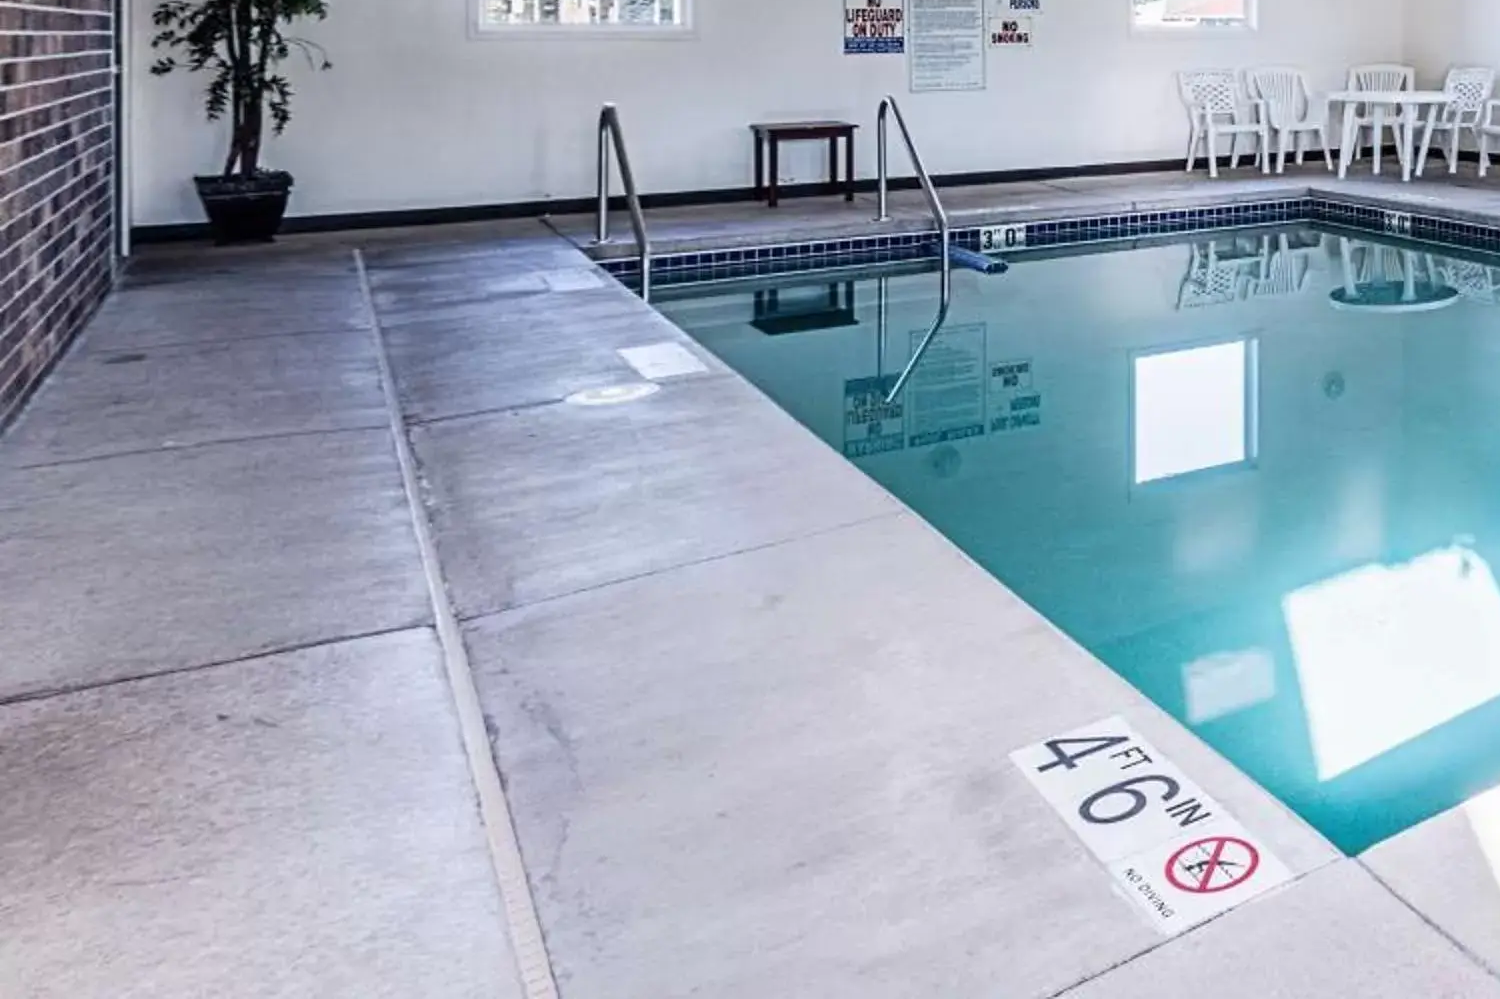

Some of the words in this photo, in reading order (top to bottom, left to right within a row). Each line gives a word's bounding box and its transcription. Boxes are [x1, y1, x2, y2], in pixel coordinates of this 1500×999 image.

[845, 8, 904, 22] LIFEGUARD
[853, 23, 867, 38] ON
[870, 23, 896, 38] DUTY
[1001, 20, 1018, 32] NO
[991, 32, 1030, 44] SMOKING
[983, 230, 993, 250] 3
[1005, 228, 1016, 248] 0
[1036, 735, 1131, 773] 4
[1109, 746, 1154, 771] FT
[1078, 774, 1182, 825] 6
[1165, 797, 1213, 828] IN
[1124, 867, 1144, 884] NO
[1137, 883, 1176, 918] DIVING
